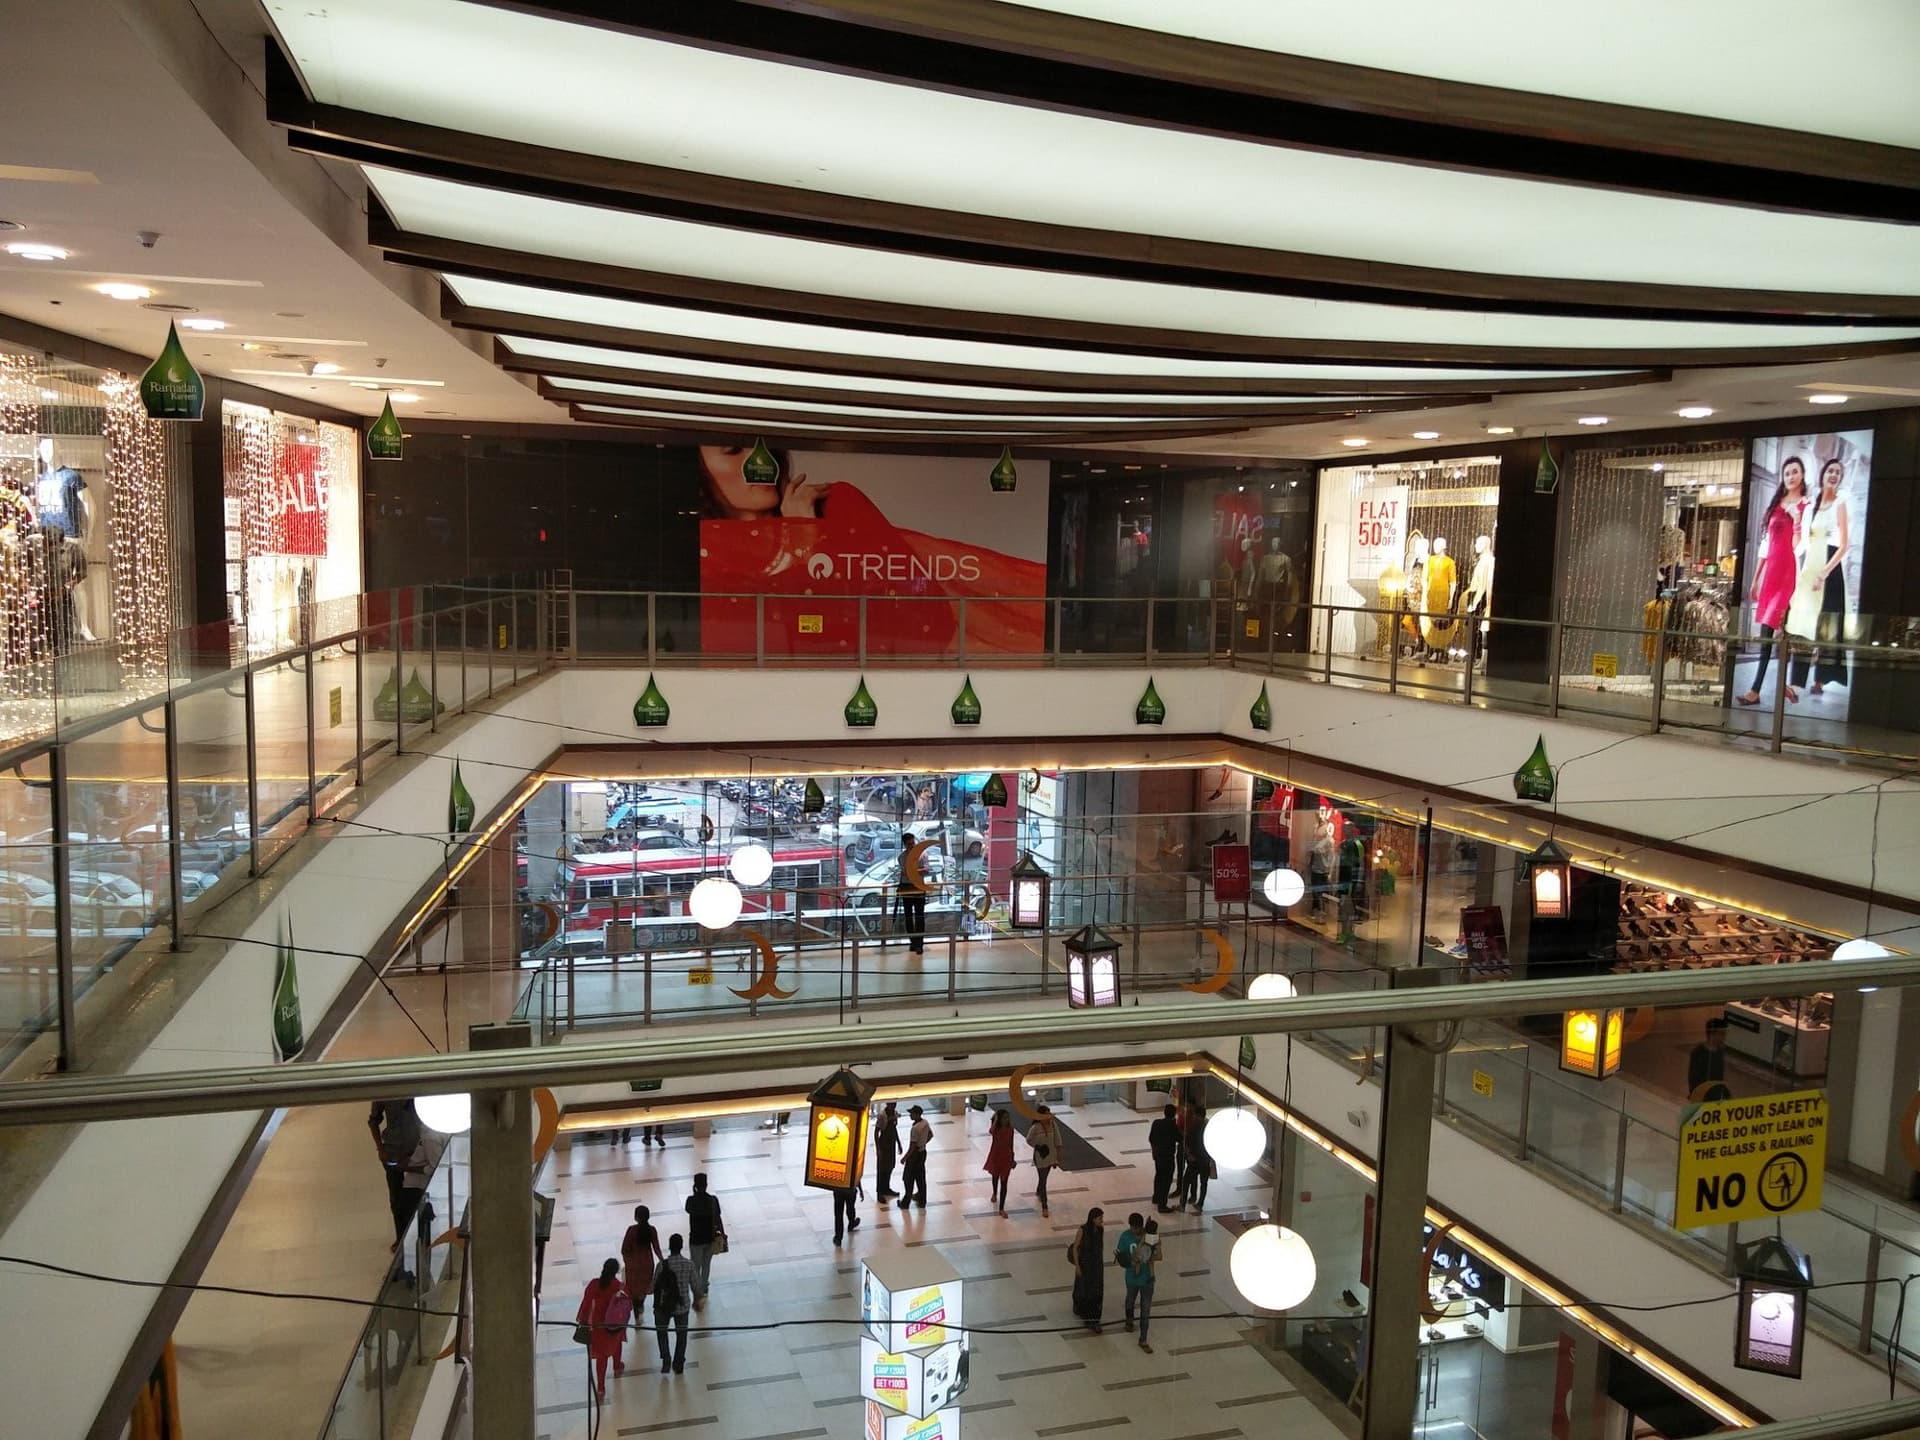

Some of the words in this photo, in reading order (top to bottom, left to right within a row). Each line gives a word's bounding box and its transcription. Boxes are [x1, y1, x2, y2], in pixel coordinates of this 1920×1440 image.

[1360, 501, 1399, 519] FLAT
[838, 553, 981, 581] TRENDS
[1216, 868, 1240, 879] 50%
[1726, 1104, 1764, 1122] YOUR
[1768, 1097, 1822, 1117] SAFETY
[1687, 1128, 1729, 1144] PLEASE
[1732, 1126, 1748, 1139] DO
[1751, 1122, 1774, 1135] NOT
[1776, 1118, 1805, 1132] LEAN
[1807, 1116, 1824, 1128] ON
[1694, 1147, 1717, 1161] THE
[1720, 1141, 1756, 1157] GLASS
[1758, 1141, 1767, 1152] &
[1770, 1134, 1814, 1150] RAILING
[1695, 1172, 1746, 1213] NO
